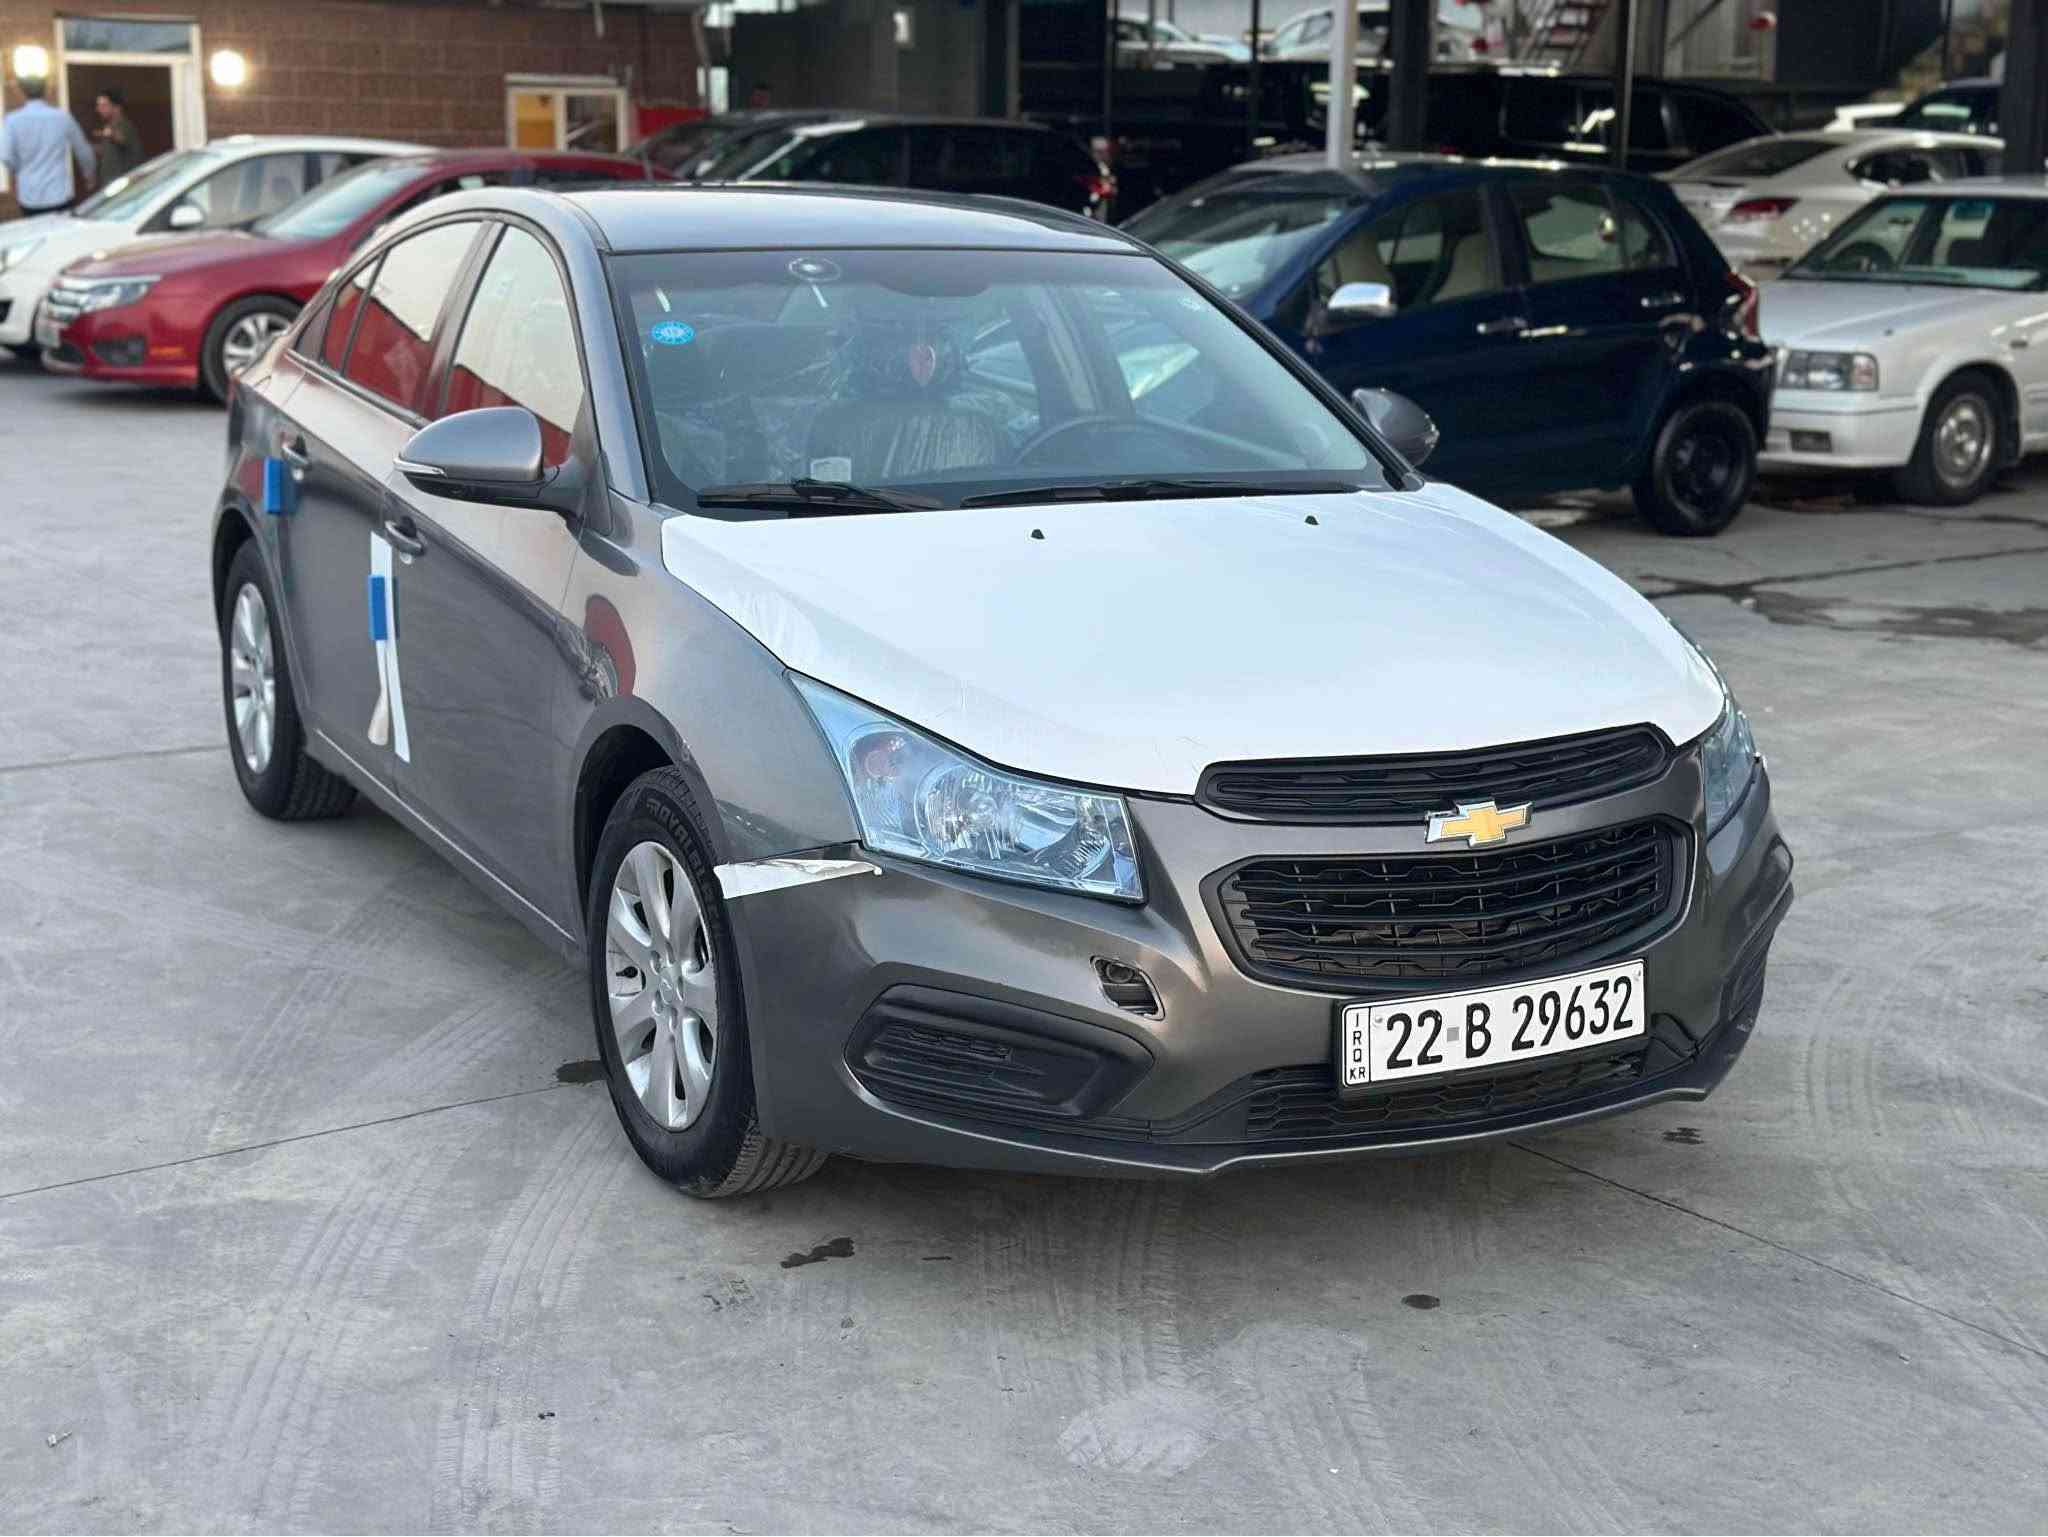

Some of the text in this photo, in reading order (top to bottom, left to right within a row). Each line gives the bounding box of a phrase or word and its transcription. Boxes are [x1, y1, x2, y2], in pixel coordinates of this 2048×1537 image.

[1386, 975, 1633, 1070] 22 B 29632
[1349, 1067, 1366, 1080] KR
